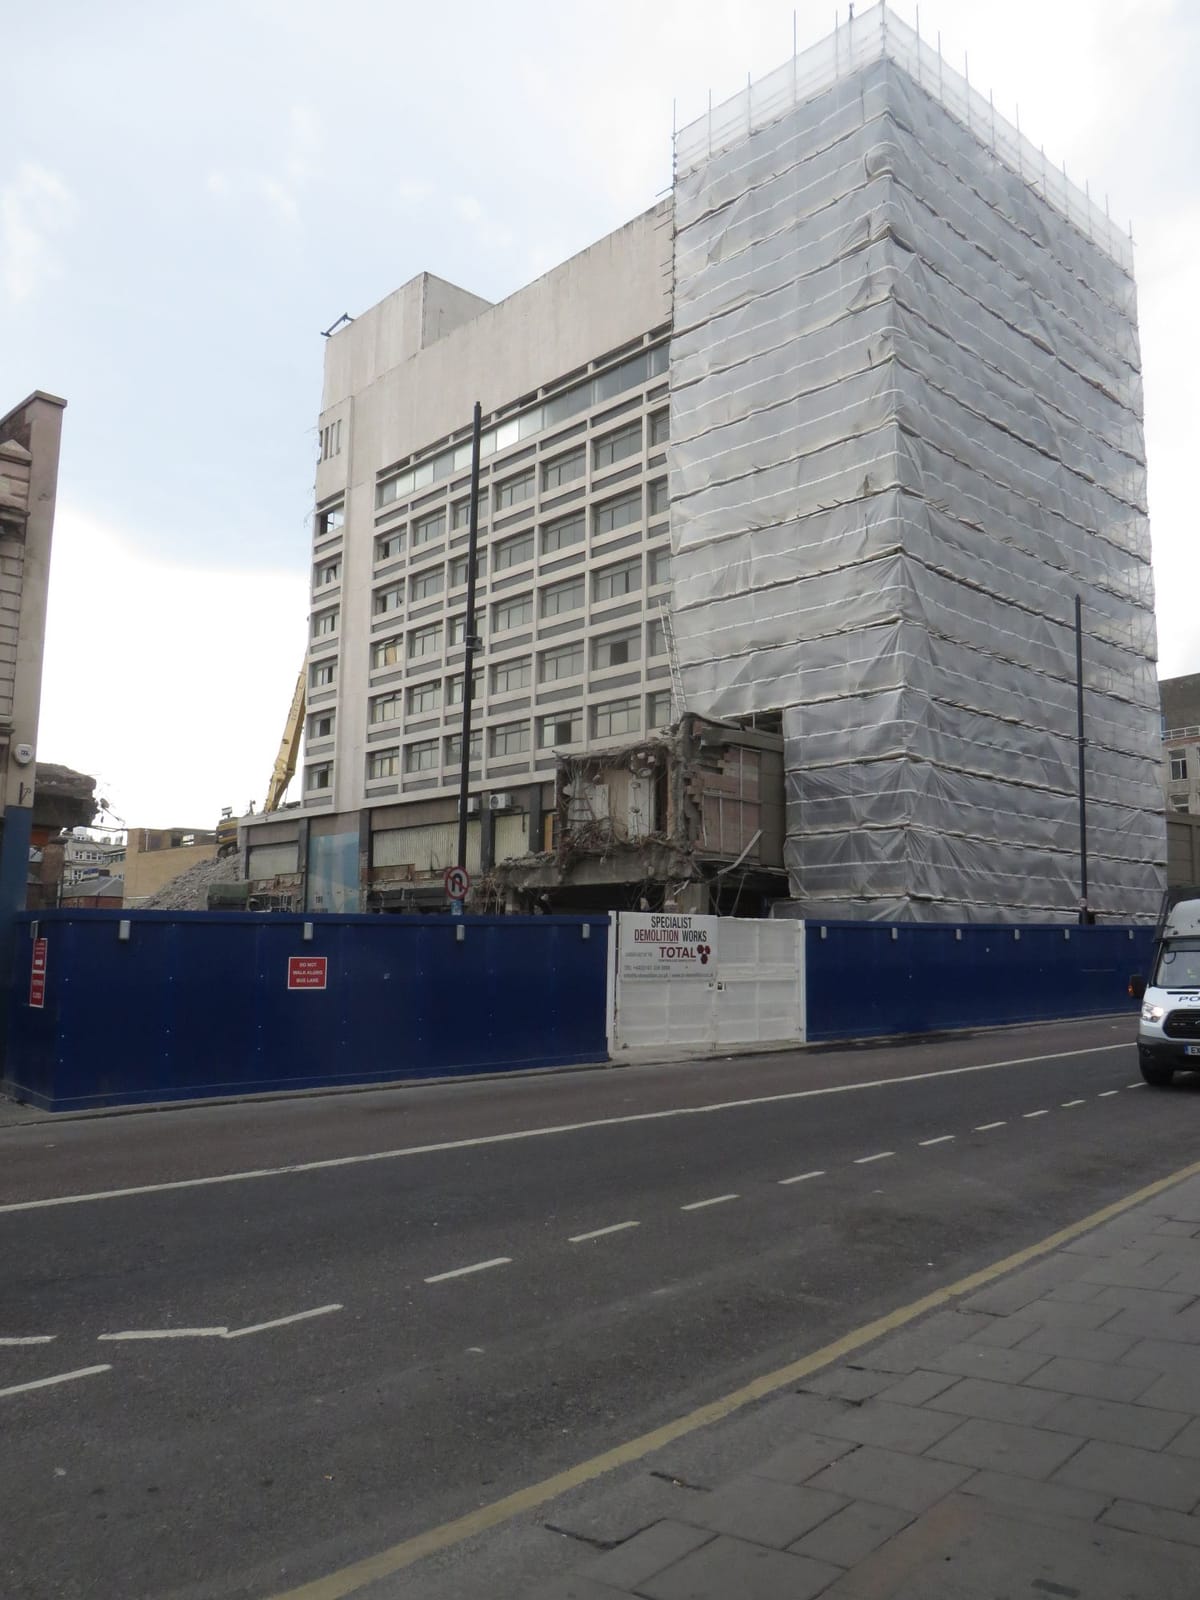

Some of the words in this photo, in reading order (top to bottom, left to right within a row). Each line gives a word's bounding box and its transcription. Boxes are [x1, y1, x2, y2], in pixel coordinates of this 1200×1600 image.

[651, 916, 692, 928] SPECIALIST
[634, 929, 679, 942] DEMOLITION
[682, 930, 707, 942] WORKS
[659, 946, 697, 958] TOTAL
